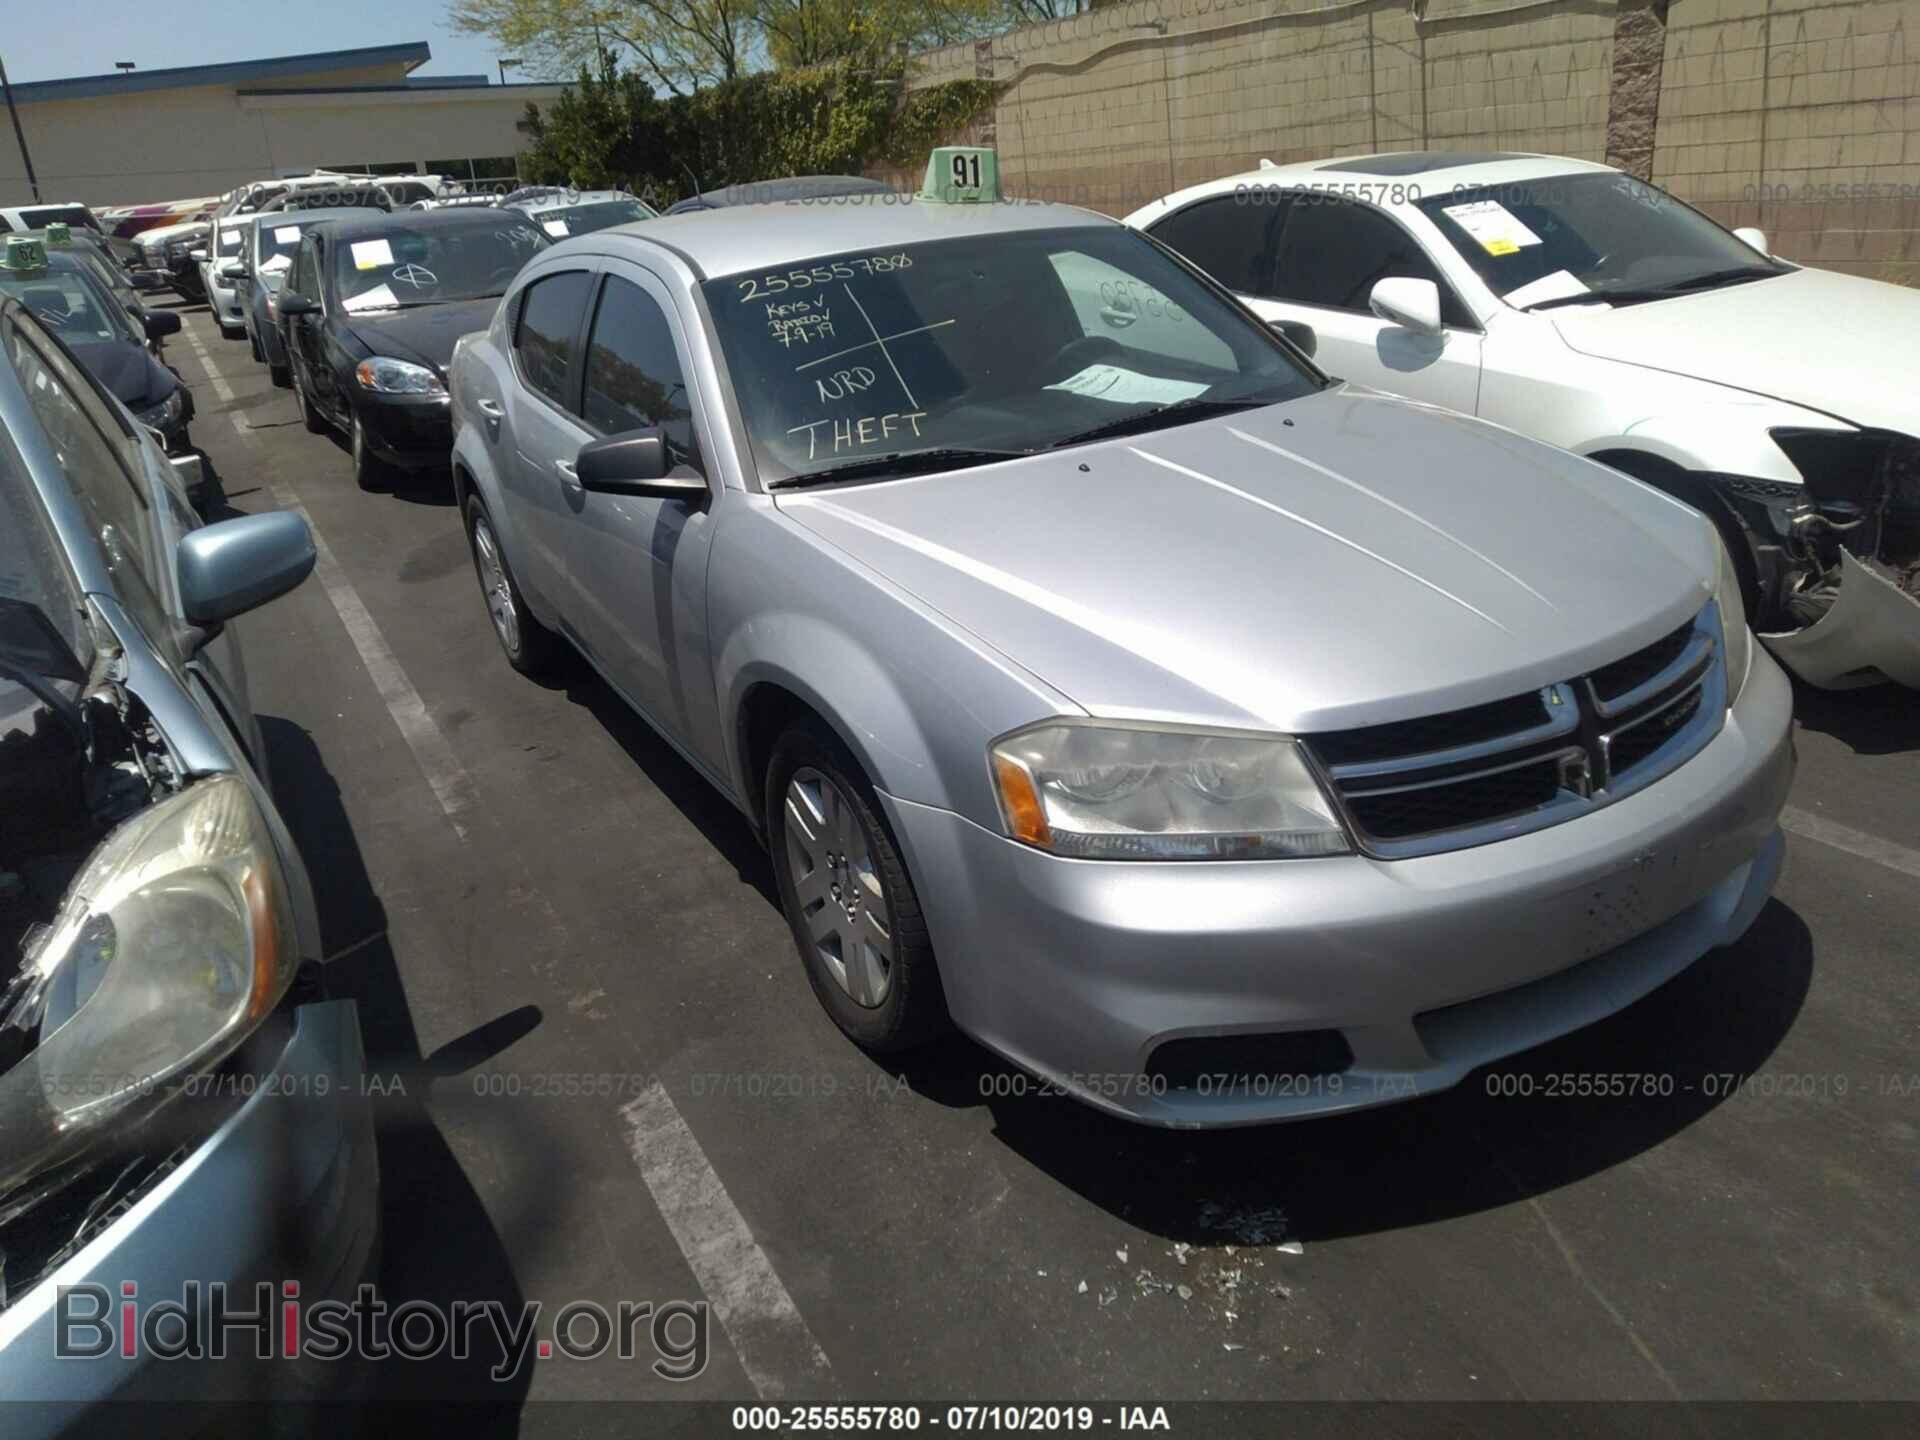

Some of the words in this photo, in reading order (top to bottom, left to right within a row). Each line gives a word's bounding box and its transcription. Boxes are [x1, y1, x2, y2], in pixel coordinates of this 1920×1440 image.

[953, 154, 980, 188] 91
[738, 252, 913, 302] 25555780
[772, 321, 836, 348] 7-9-19
[816, 366, 876, 403] NRD
[786, 412, 928, 459] THEFT
